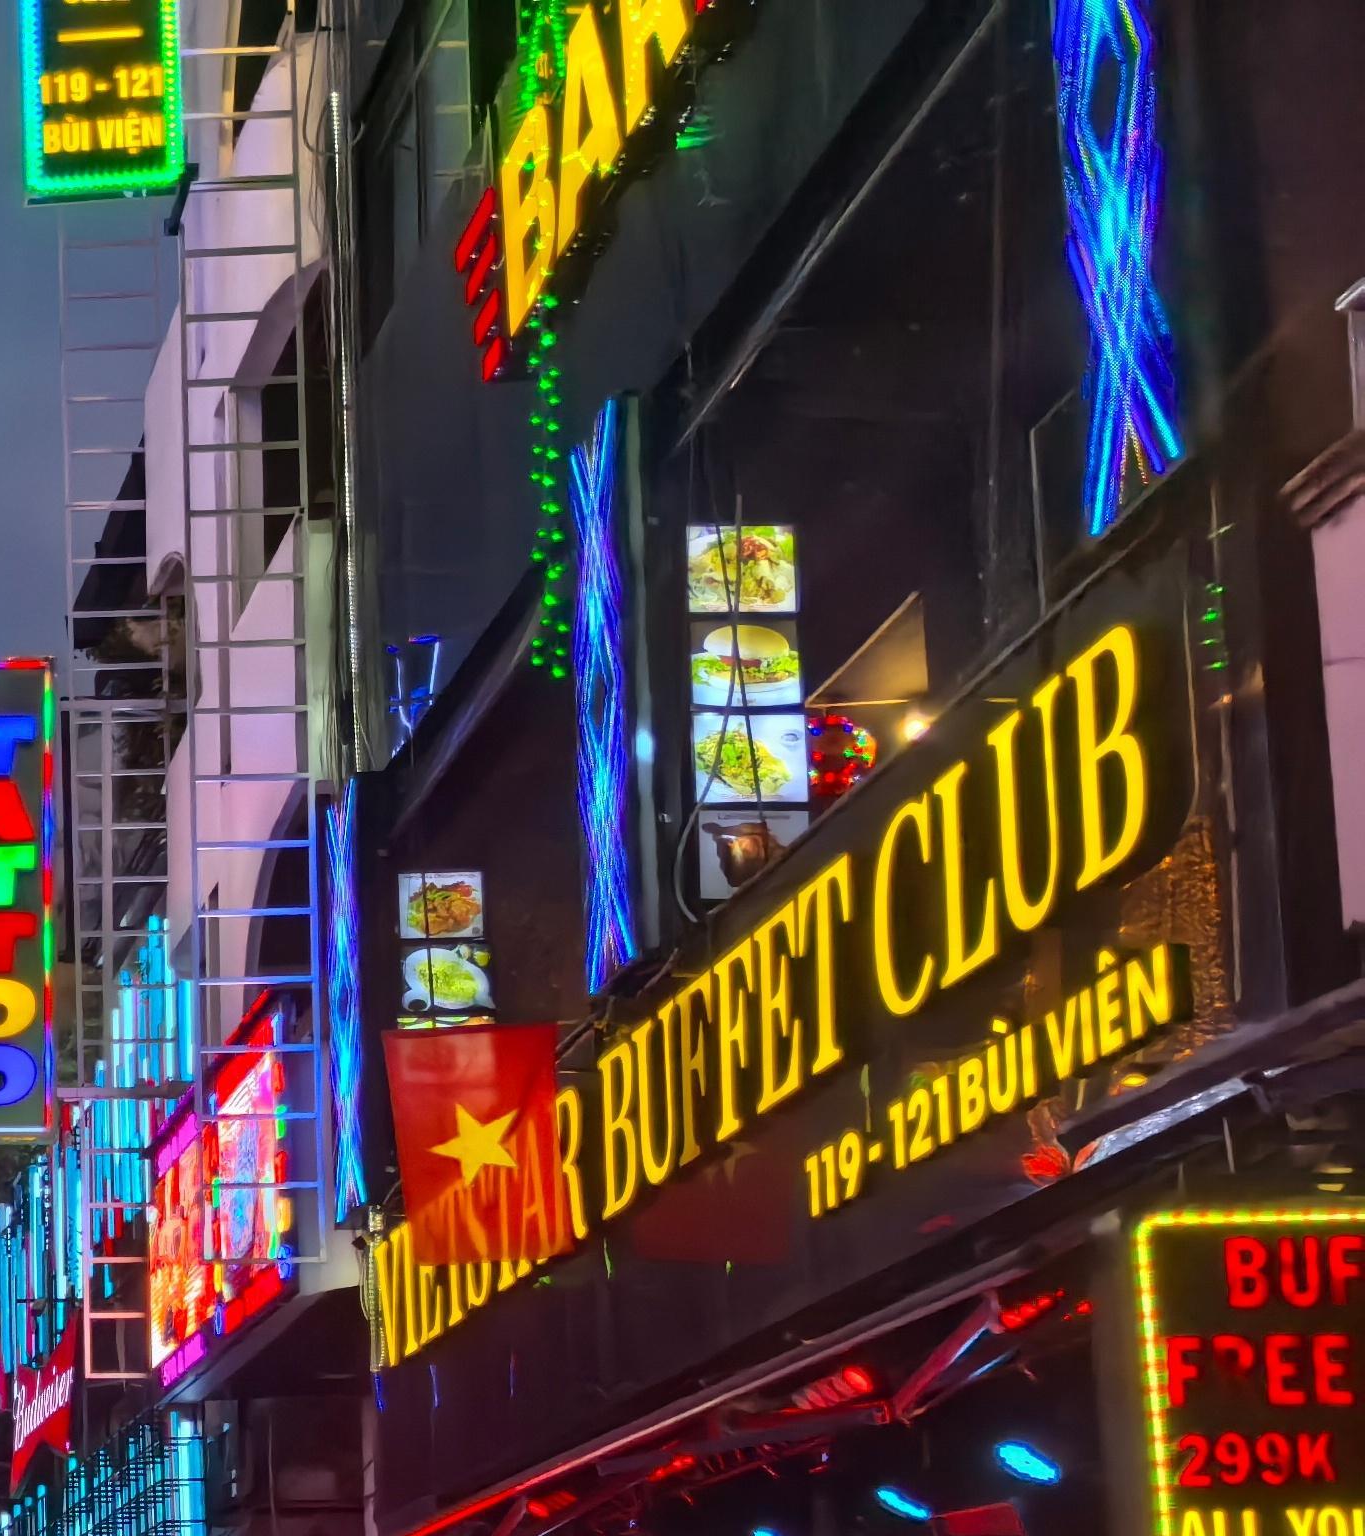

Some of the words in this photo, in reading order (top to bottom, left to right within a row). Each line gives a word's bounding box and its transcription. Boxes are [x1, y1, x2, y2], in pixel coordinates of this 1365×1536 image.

[38, 69, 89, 105] 119
[113, 65, 163, 98] 121
[42, 113, 91, 154] BÙI
[96, 109, 163, 155] VIỆN
[597, 853, 855, 1221] BUFFET
[875, 623, 1149, 1017] CLUB
[957, 1017, 1038, 1134] BÙI
[1223, 1235, 1365, 1309] BUF
[12, 1365, 74, 1452] Budweiser
[1178, 1431, 1337, 1489] 299K
